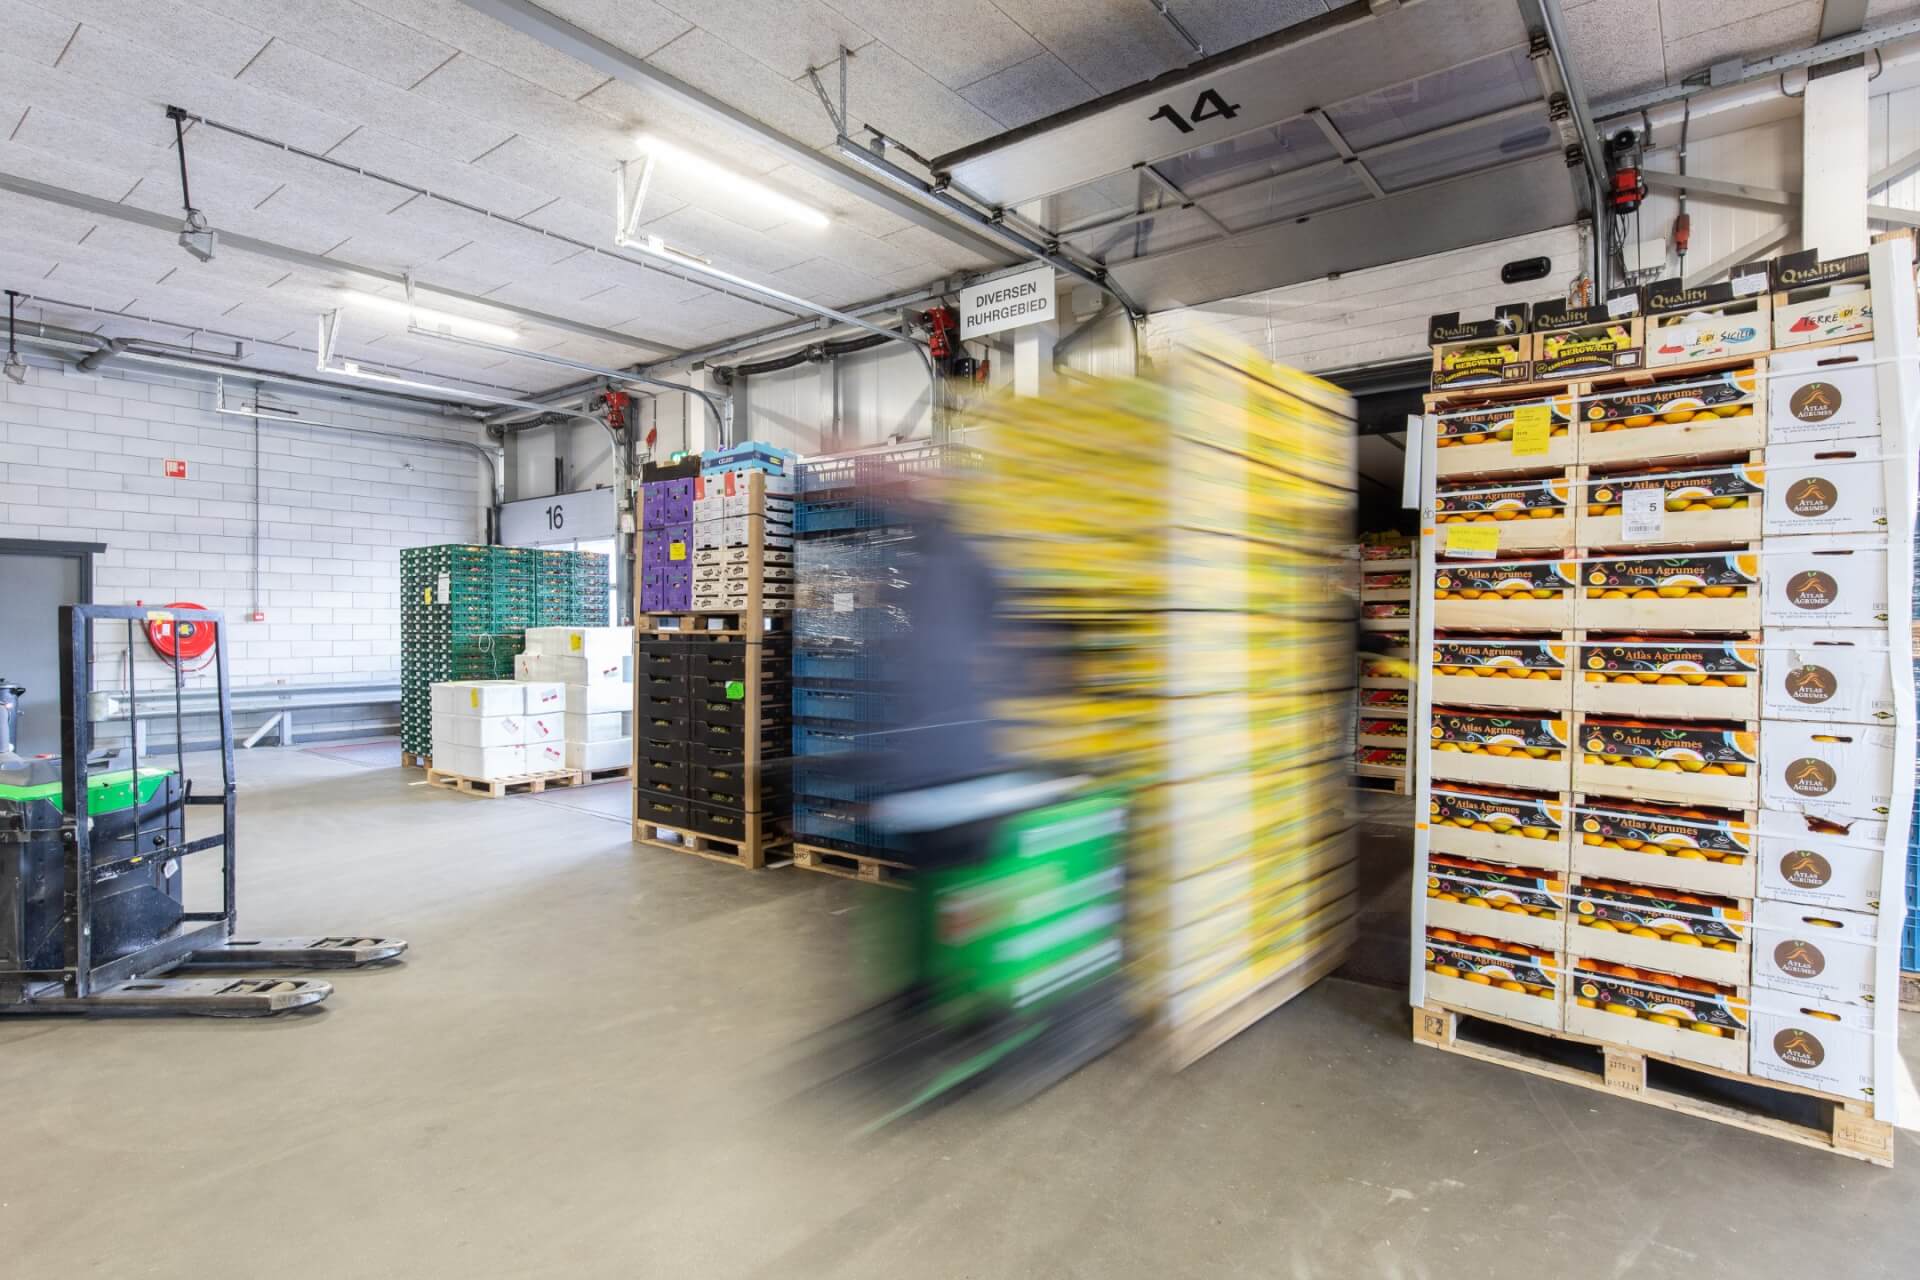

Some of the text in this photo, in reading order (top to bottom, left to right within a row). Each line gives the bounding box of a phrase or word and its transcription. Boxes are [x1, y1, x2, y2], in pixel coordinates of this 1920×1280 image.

[1149, 88, 1240, 133] 14
[1780, 262, 1847, 284] Quality
[975, 282, 1037, 308] DIVERSEN
[1650, 289, 1707, 308] Quality
[967, 298, 1047, 328] RUHRGEBIED
[1802, 312, 1839, 327] TERRE
[1537, 311, 1587, 330] Quality
[1434, 324, 1478, 339] Quality
[1720, 328, 1755, 341] SICILIA
[1624, 389, 1703, 405] Atlas Agrumes
[1632, 478, 1712, 489] Atlas Agrumes
[1649, 502, 1657, 512] 5
[546, 504, 564, 530] 16
[1467, 570, 1533, 580] Atlas Agrumes
[1626, 565, 1705, 576] Atlas Agrumes
[1800, 591, 1824, 599] ATLAS
[1459, 647, 1523, 658] Atlas Agrumes
[1625, 651, 1704, 663] Atlas Agrumes
[1799, 686, 1823, 694] ATLAS
[1460, 723, 1525, 737] Atlas Agrumes
[1624, 735, 1703, 752] Atlas Agrumes
[1798, 779, 1823, 787] ATLAS
[1456, 800, 1520, 815] Atlas Agrumes
[1620, 818, 1698, 838] Atlas Agrumes
[1794, 871, 1818, 879] ATLAS
[1787, 959, 1812, 968] ATLAS
[1619, 986, 1696, 1008] Atlas Agrumes
[1786, 1049, 1812, 1058] ATLAS
